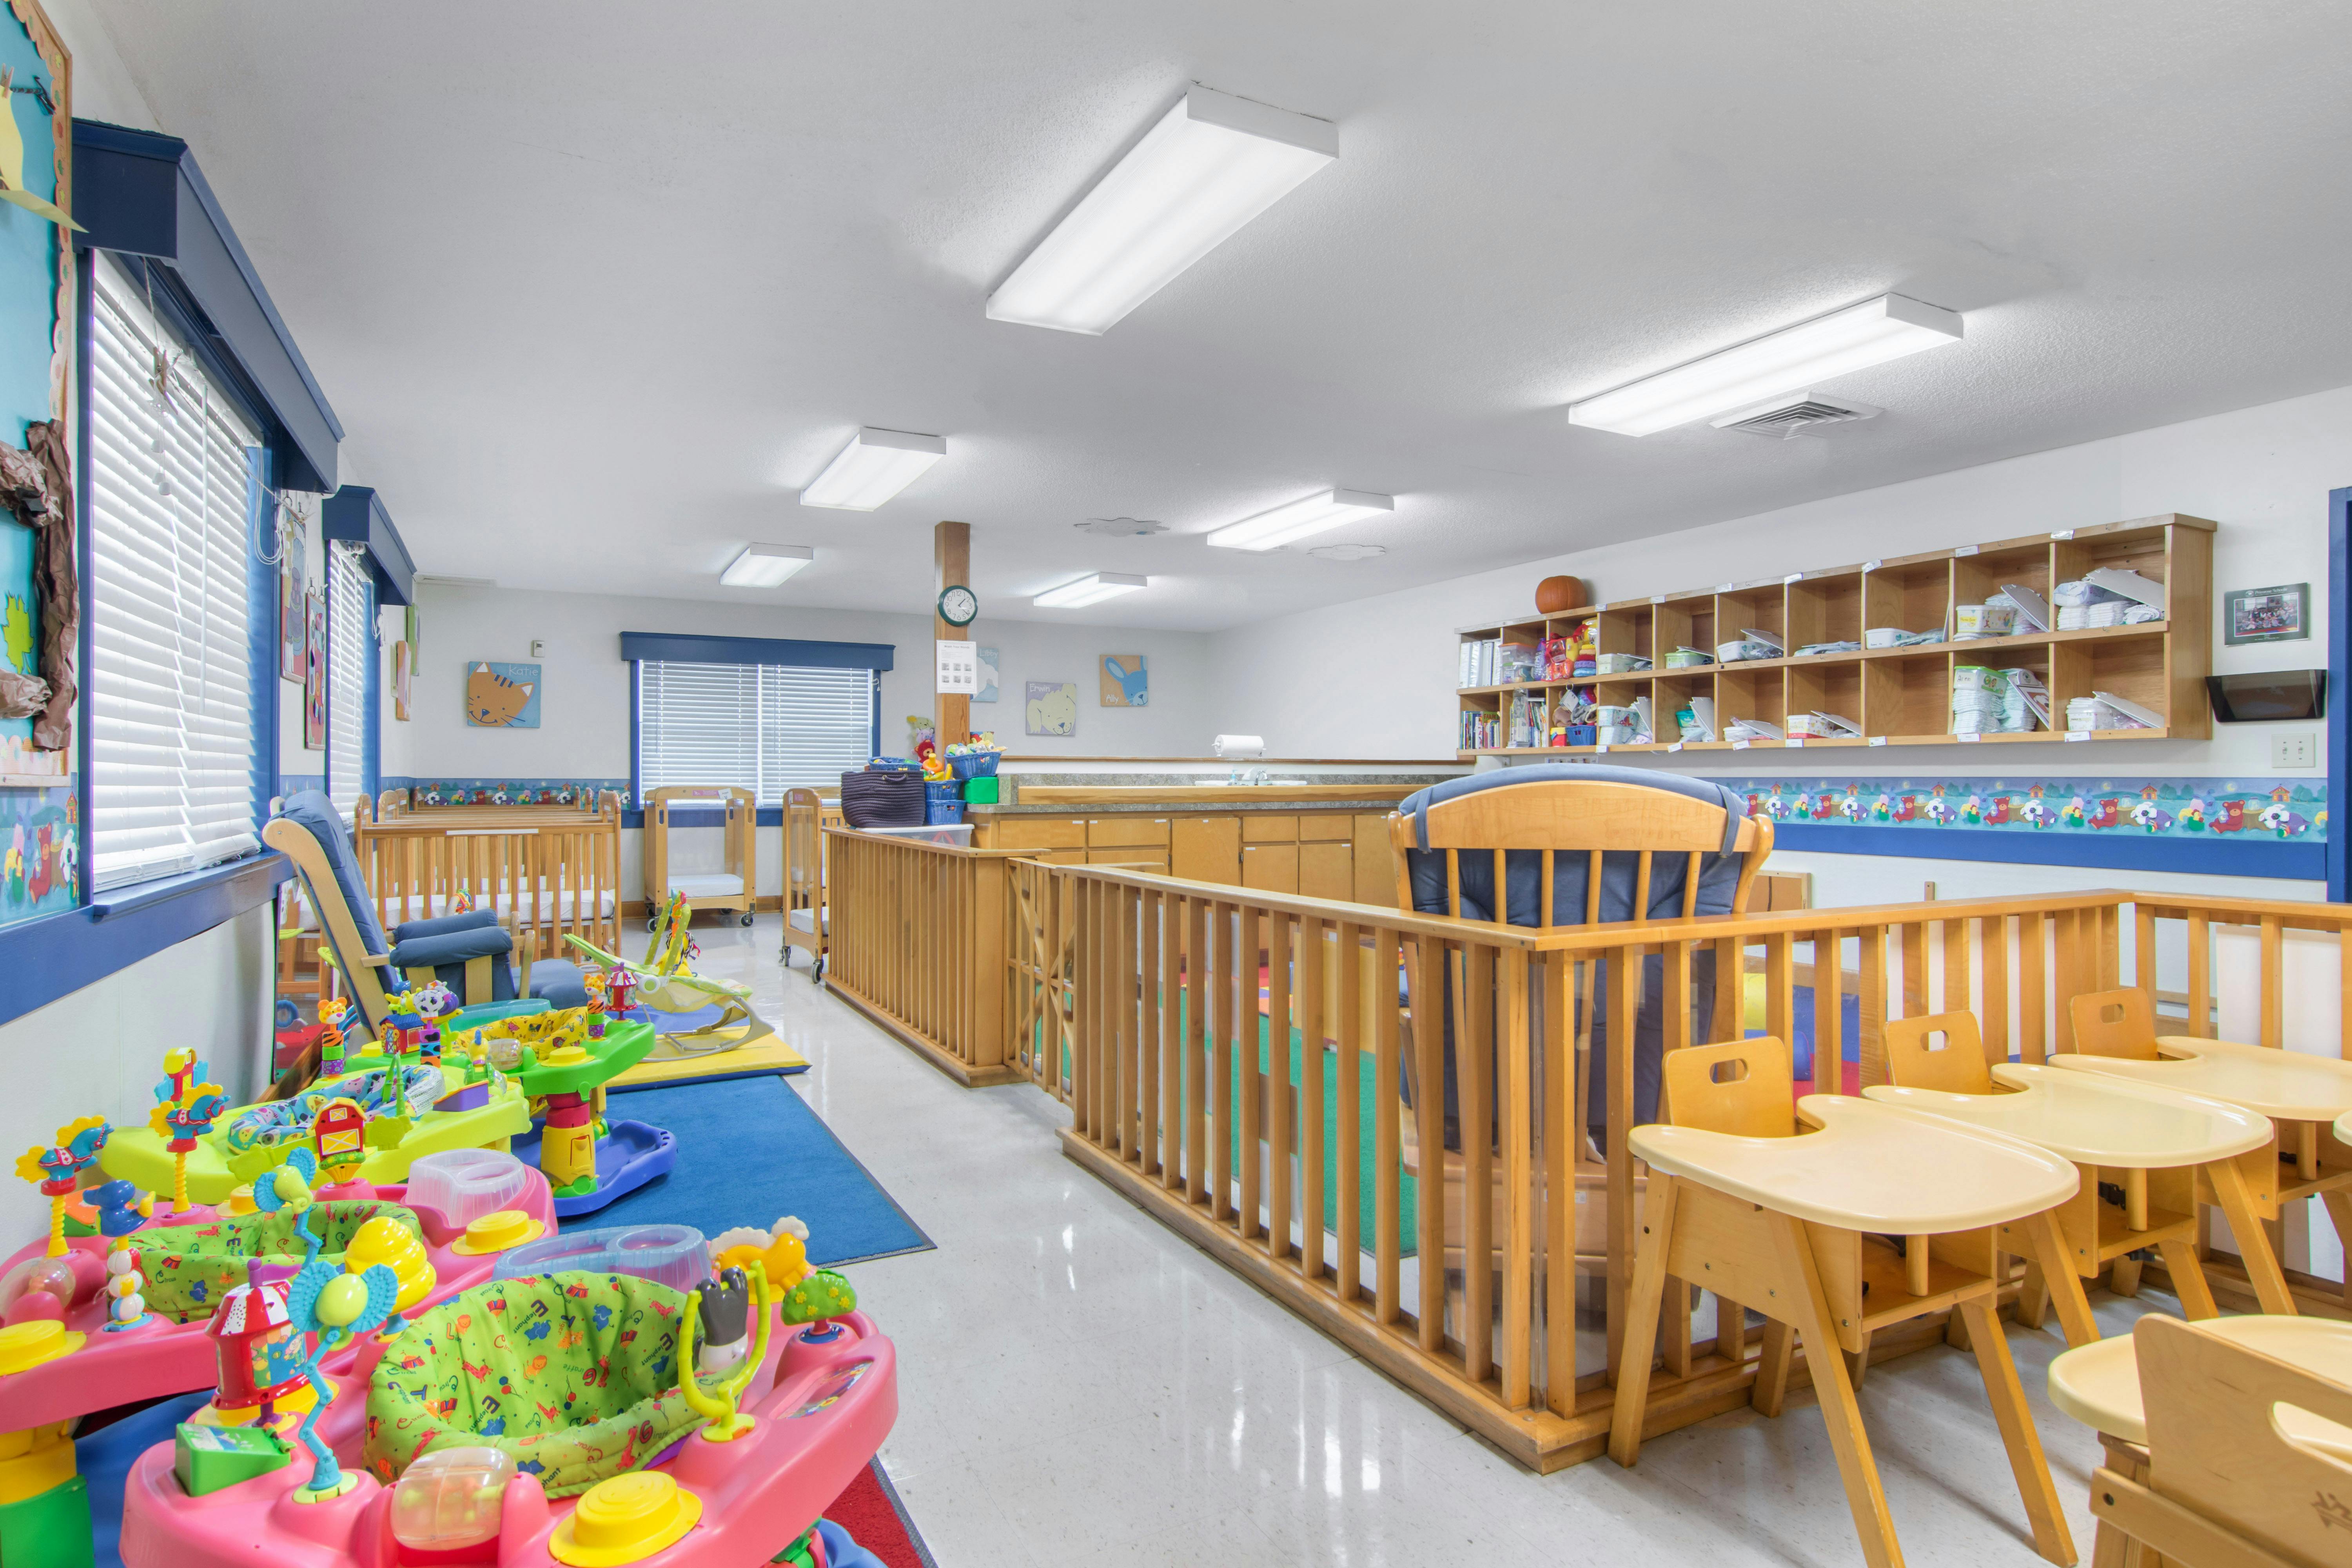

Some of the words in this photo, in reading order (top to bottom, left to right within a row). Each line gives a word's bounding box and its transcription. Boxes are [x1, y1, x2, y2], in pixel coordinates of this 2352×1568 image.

[979, 649, 998, 659] Libby
[509, 664, 539, 676] Katie
[1029, 683, 1050, 692] Erwin
[1106, 694, 1119, 704] Ally
[156, 1270, 176, 1284] Circus
[479, 1283, 504, 1297] Circus
[514, 1299, 549, 1334] Elephant
[446, 1322, 462, 1342] Lion
[641, 1332, 674, 1366] Elephant
[563, 1363, 597, 1387] Giraffe
[469, 1395, 501, 1433] Elephant
